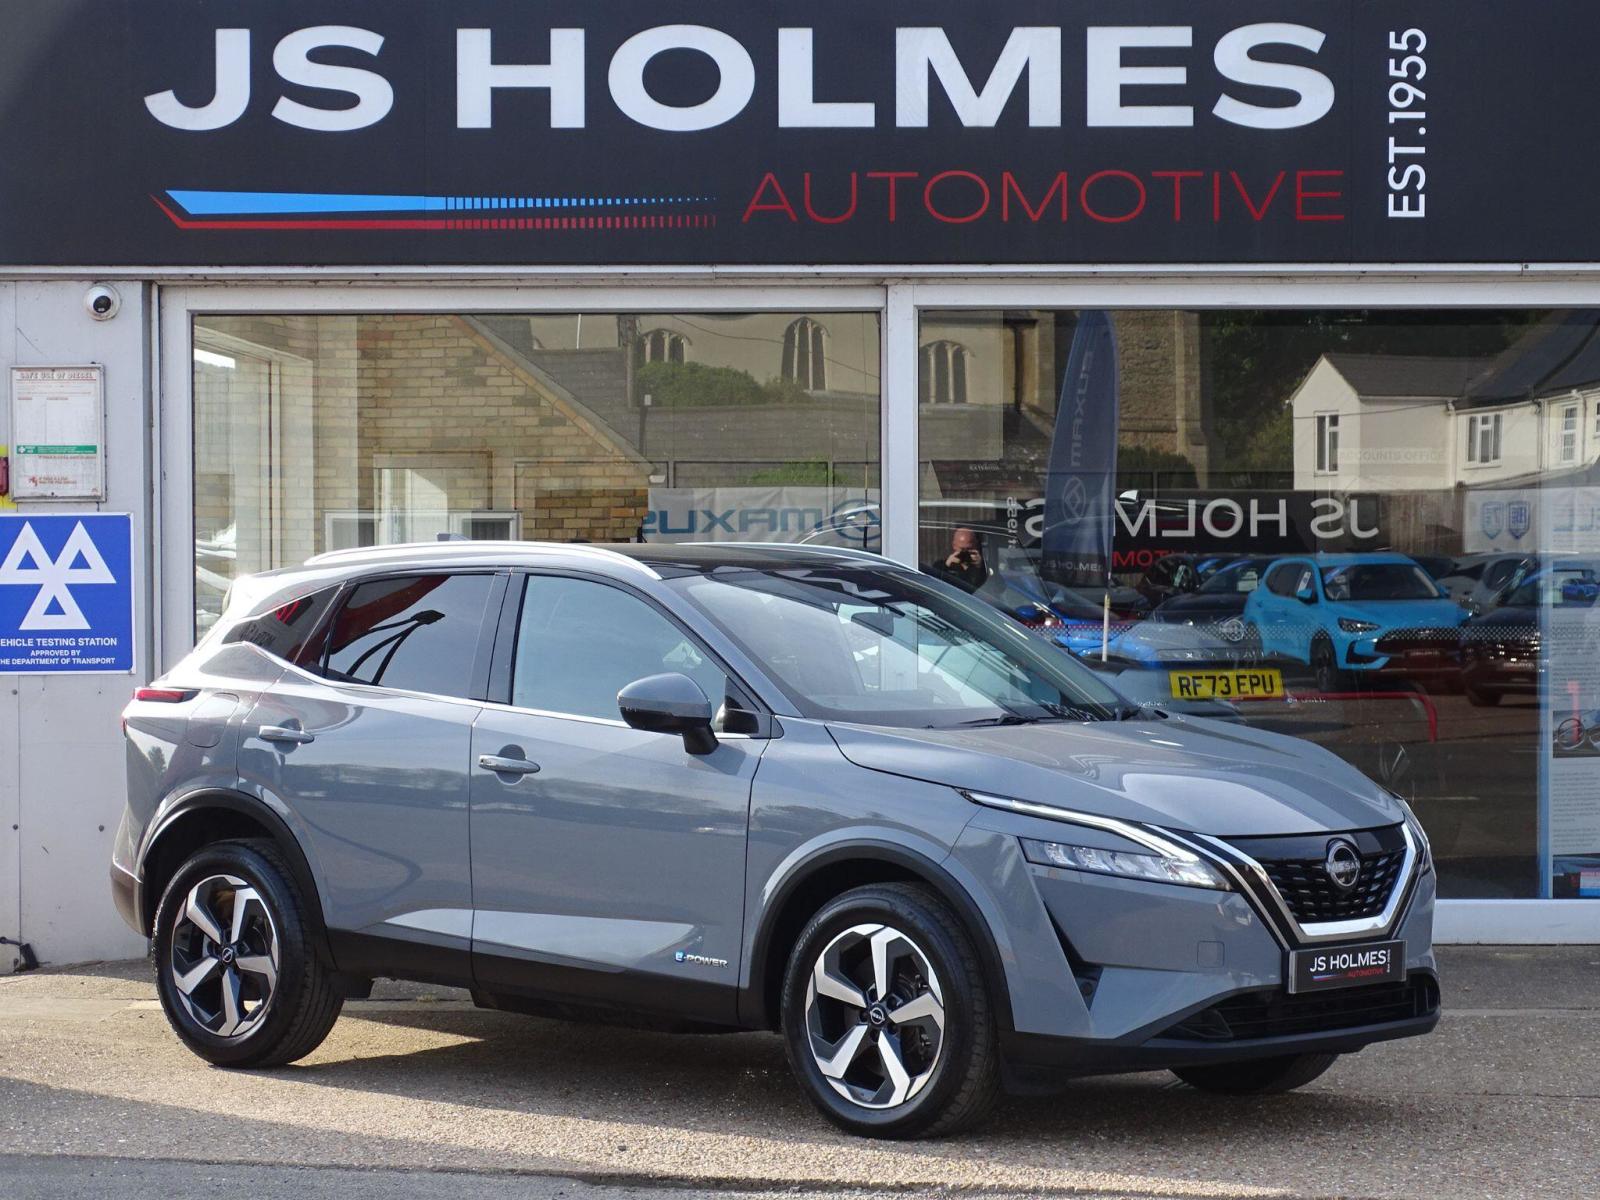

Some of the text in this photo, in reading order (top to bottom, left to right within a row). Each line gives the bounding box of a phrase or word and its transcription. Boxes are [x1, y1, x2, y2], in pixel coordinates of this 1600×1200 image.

[143, 22, 1336, 132] JS HOLMES
[1387, 28, 1428, 218] EST.1955
[741, 169, 1345, 224] AUTOMOTIVE
[0, 637, 118, 647] EHICLE TESTING STATION
[1177, 674, 1275, 697] RF73 EPU
[1309, 956, 1327, 972] JS
[1330, 950, 1386, 969] HOLMES
